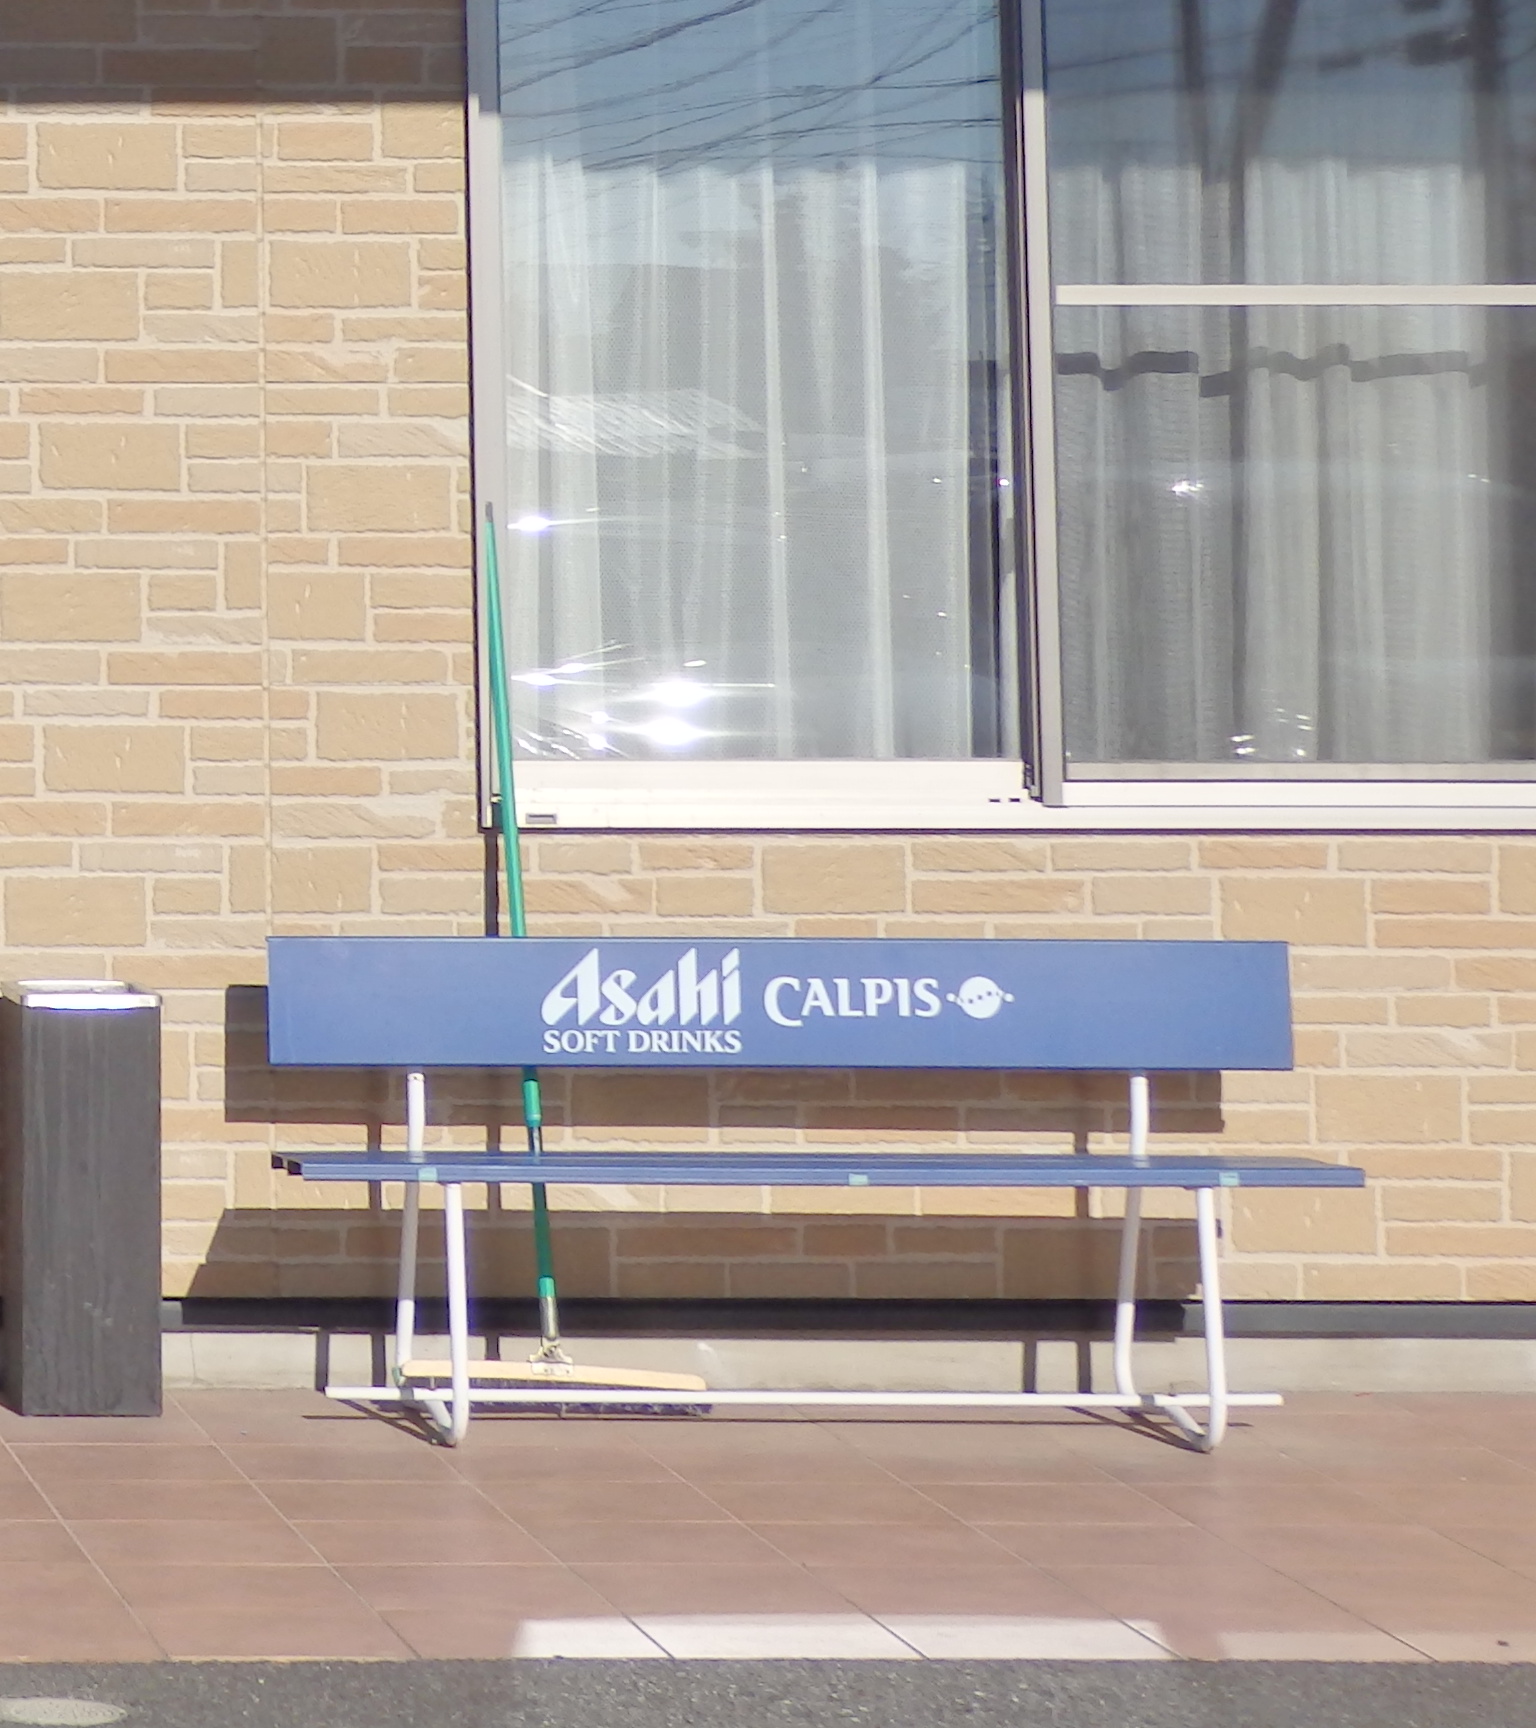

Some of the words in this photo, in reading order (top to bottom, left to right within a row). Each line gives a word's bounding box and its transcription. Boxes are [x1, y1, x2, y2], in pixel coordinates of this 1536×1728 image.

[541, 947, 743, 1027] Asahi
[763, 976, 941, 1028] CALPIS
[543, 1029, 622, 1054] SOFT
[627, 1029, 743, 1055] DRINKS
